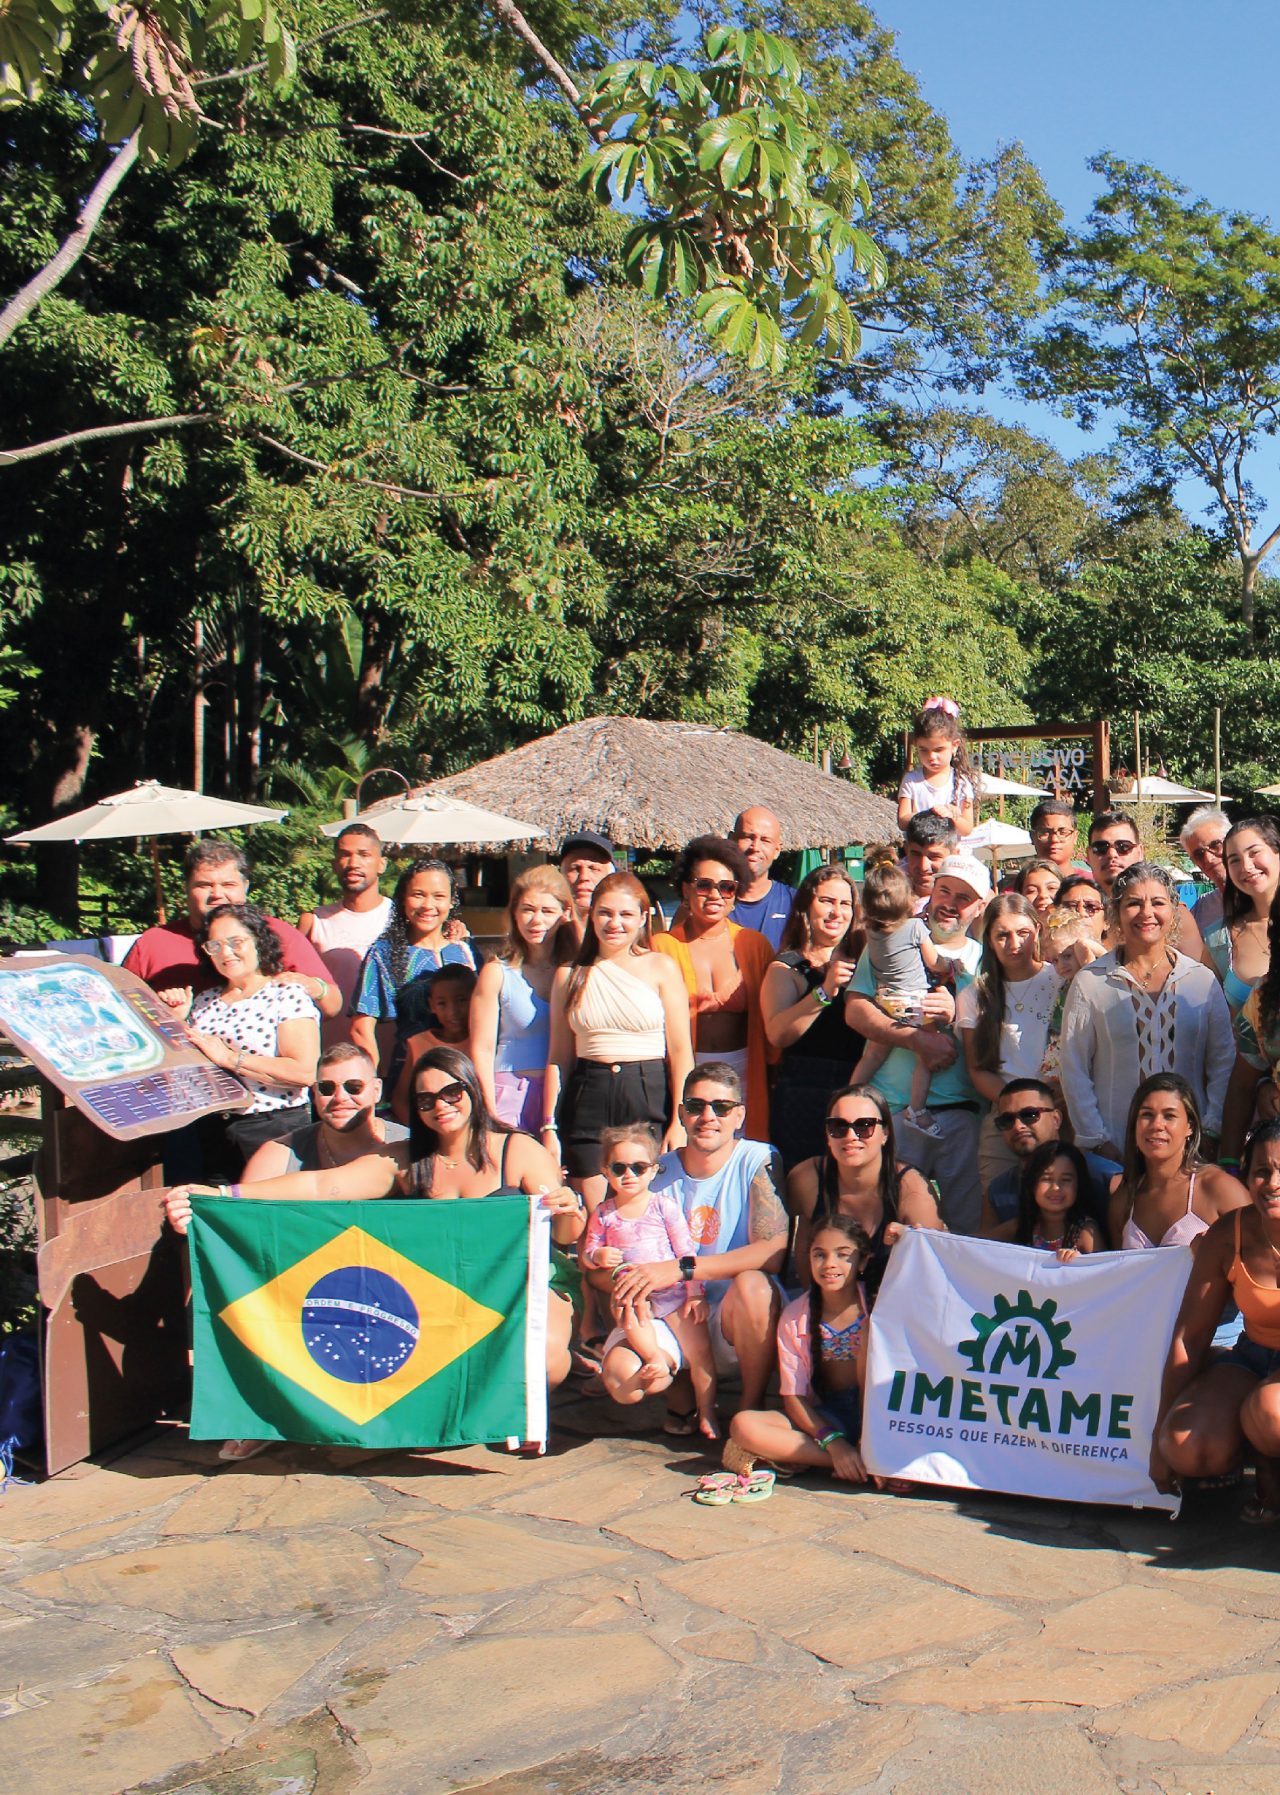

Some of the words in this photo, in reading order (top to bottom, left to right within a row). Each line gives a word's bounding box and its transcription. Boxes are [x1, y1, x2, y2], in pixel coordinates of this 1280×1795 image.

[987, 748, 1085, 769] EXCLUSIVO
[305, 1299, 341, 1307] ORDEM
[359, 1304, 417, 1335] PROGRESSO
[887, 1370, 1134, 1439] IMETAME
[889, 1419, 954, 1439] PESSOAS
[959, 1428, 989, 1444] QUE
[993, 1432, 1037, 1449] FAZEM
[1051, 1441, 1129, 1463] DIFERENÇA
